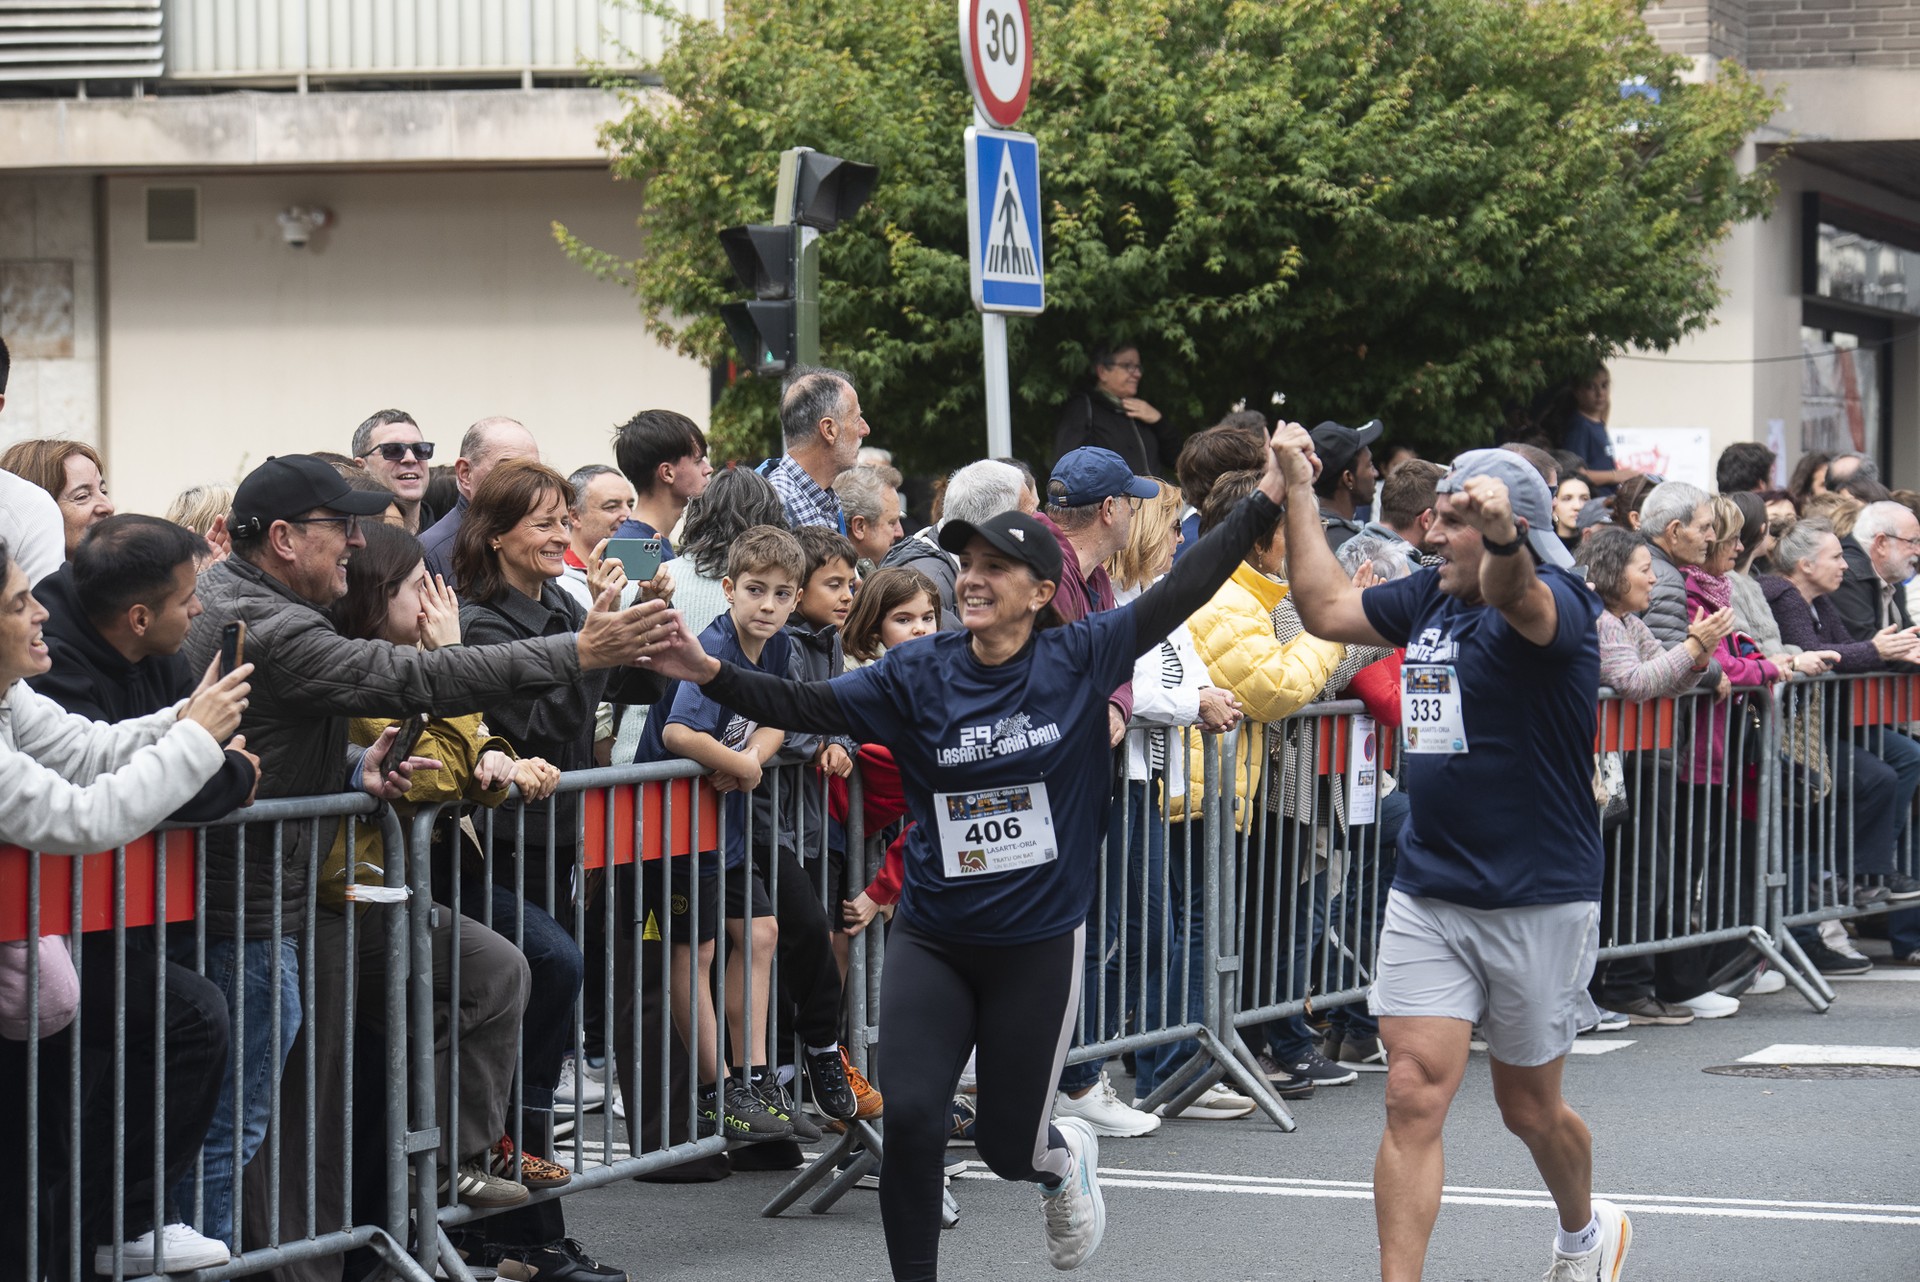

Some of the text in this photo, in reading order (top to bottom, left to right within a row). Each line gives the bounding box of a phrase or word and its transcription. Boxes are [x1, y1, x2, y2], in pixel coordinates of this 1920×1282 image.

[986, 9, 1017, 66] 30
[1411, 699, 1441, 722] 333
[960, 725, 991, 747] 29
[965, 817, 1022, 845] 406
[986, 840, 1037, 854] LASARTE-ORIA
[704, 1110, 751, 1132] adas
